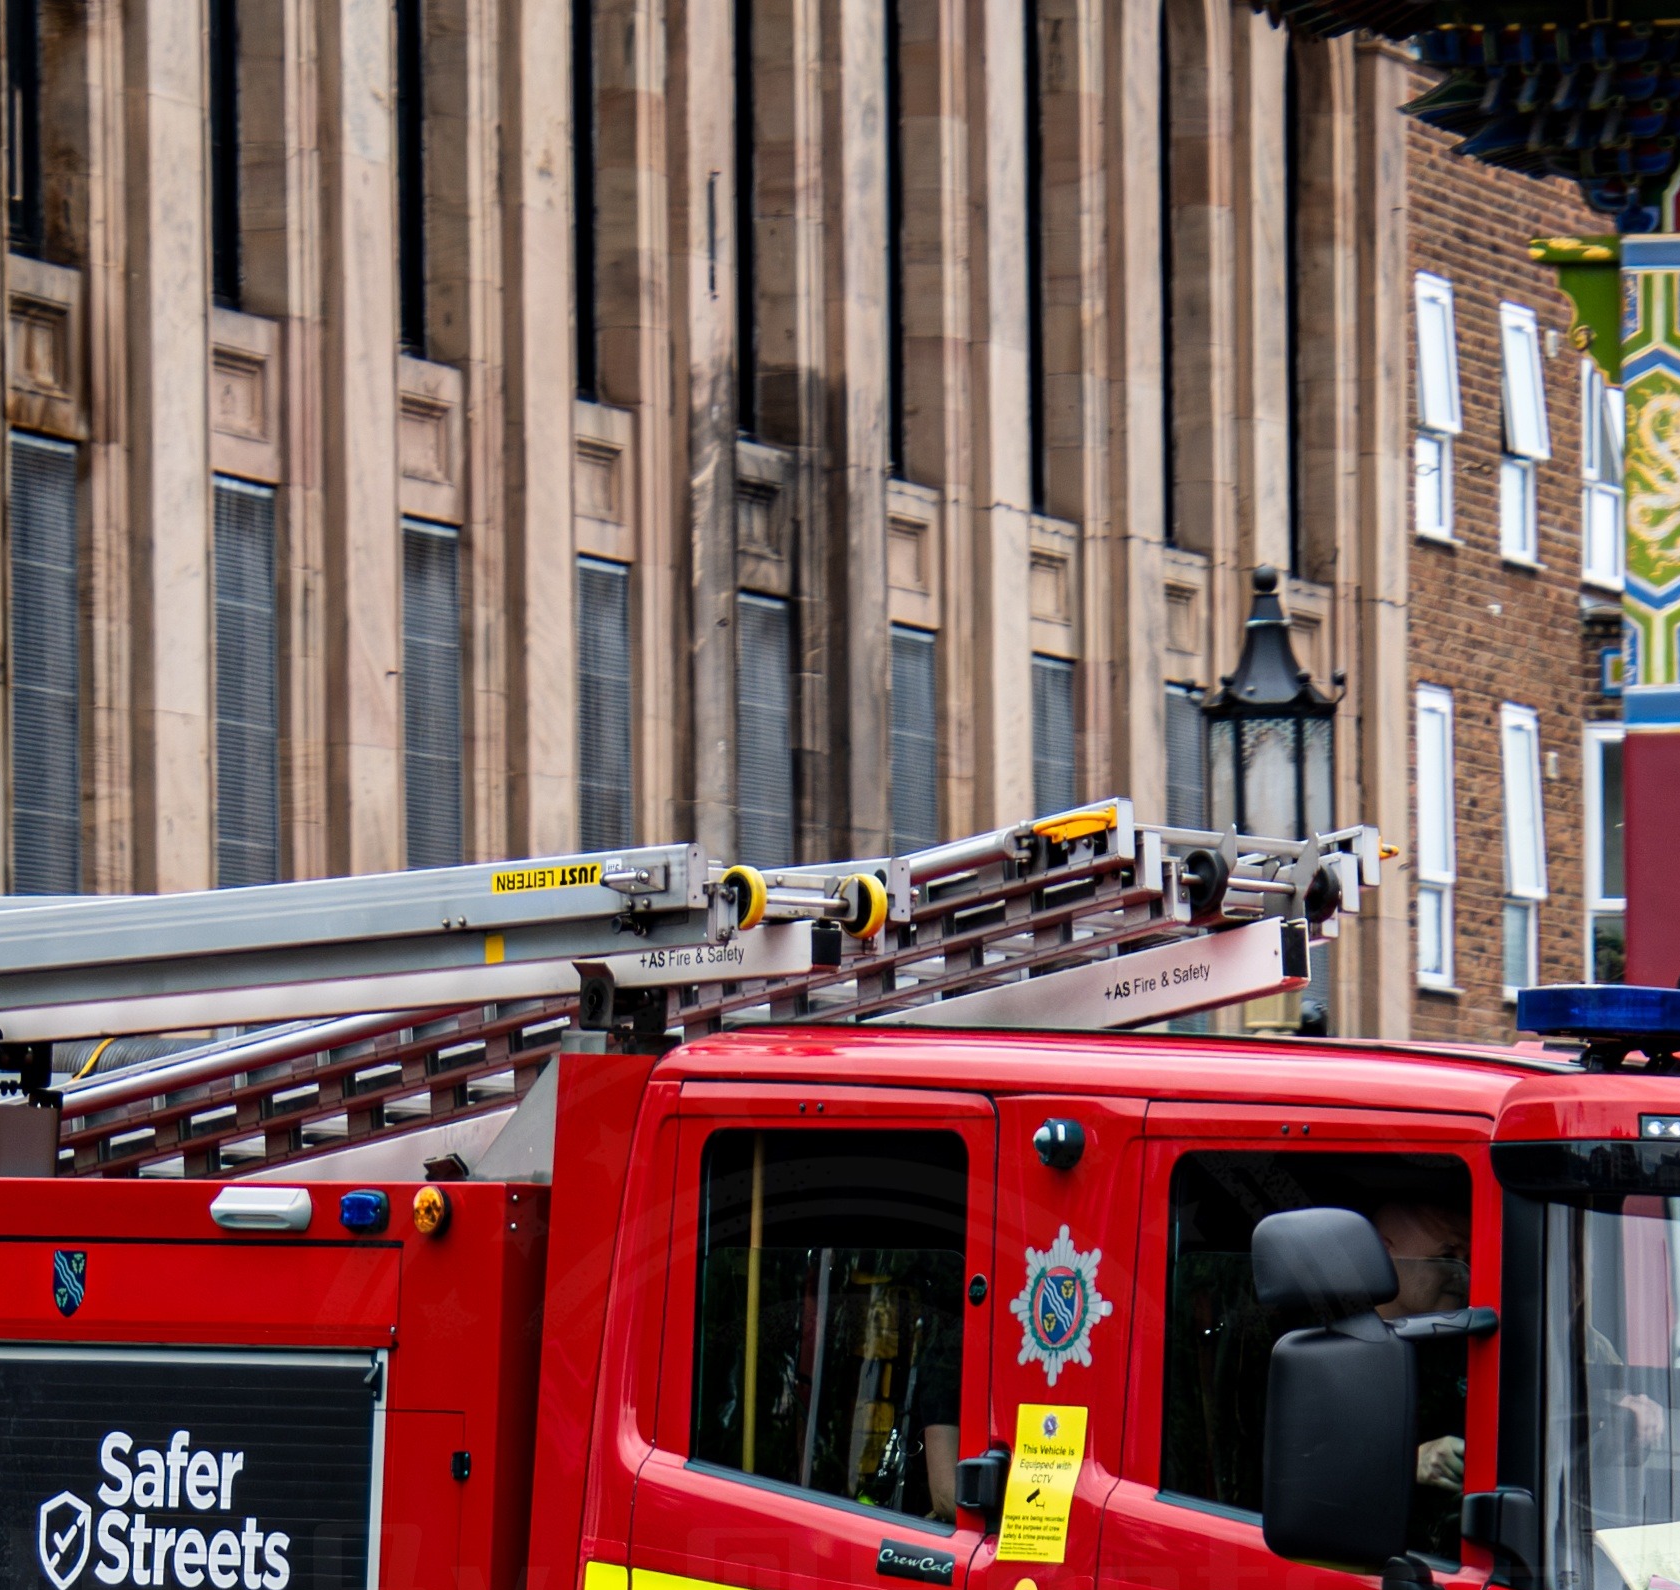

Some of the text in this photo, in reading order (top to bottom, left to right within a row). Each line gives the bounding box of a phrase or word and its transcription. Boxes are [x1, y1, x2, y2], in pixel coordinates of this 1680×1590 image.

[496, 870, 555, 892] LEITERN
[559, 865, 598, 886] JUST
[668, 949, 691, 967] Fire
[695, 948, 704, 964] &
[707, 946, 745, 965] Safety
[1134, 977, 1157, 995] Fire
[1161, 970, 1170, 988] &
[1173, 962, 1211, 985] Safety
[1023, 1444, 1075, 1456] This Vehicle is
[97, 1430, 245, 1511] Safer
[1020, 1459, 1072, 1471] Equipped with
[1031, 1474, 1053, 1483] CCTV
